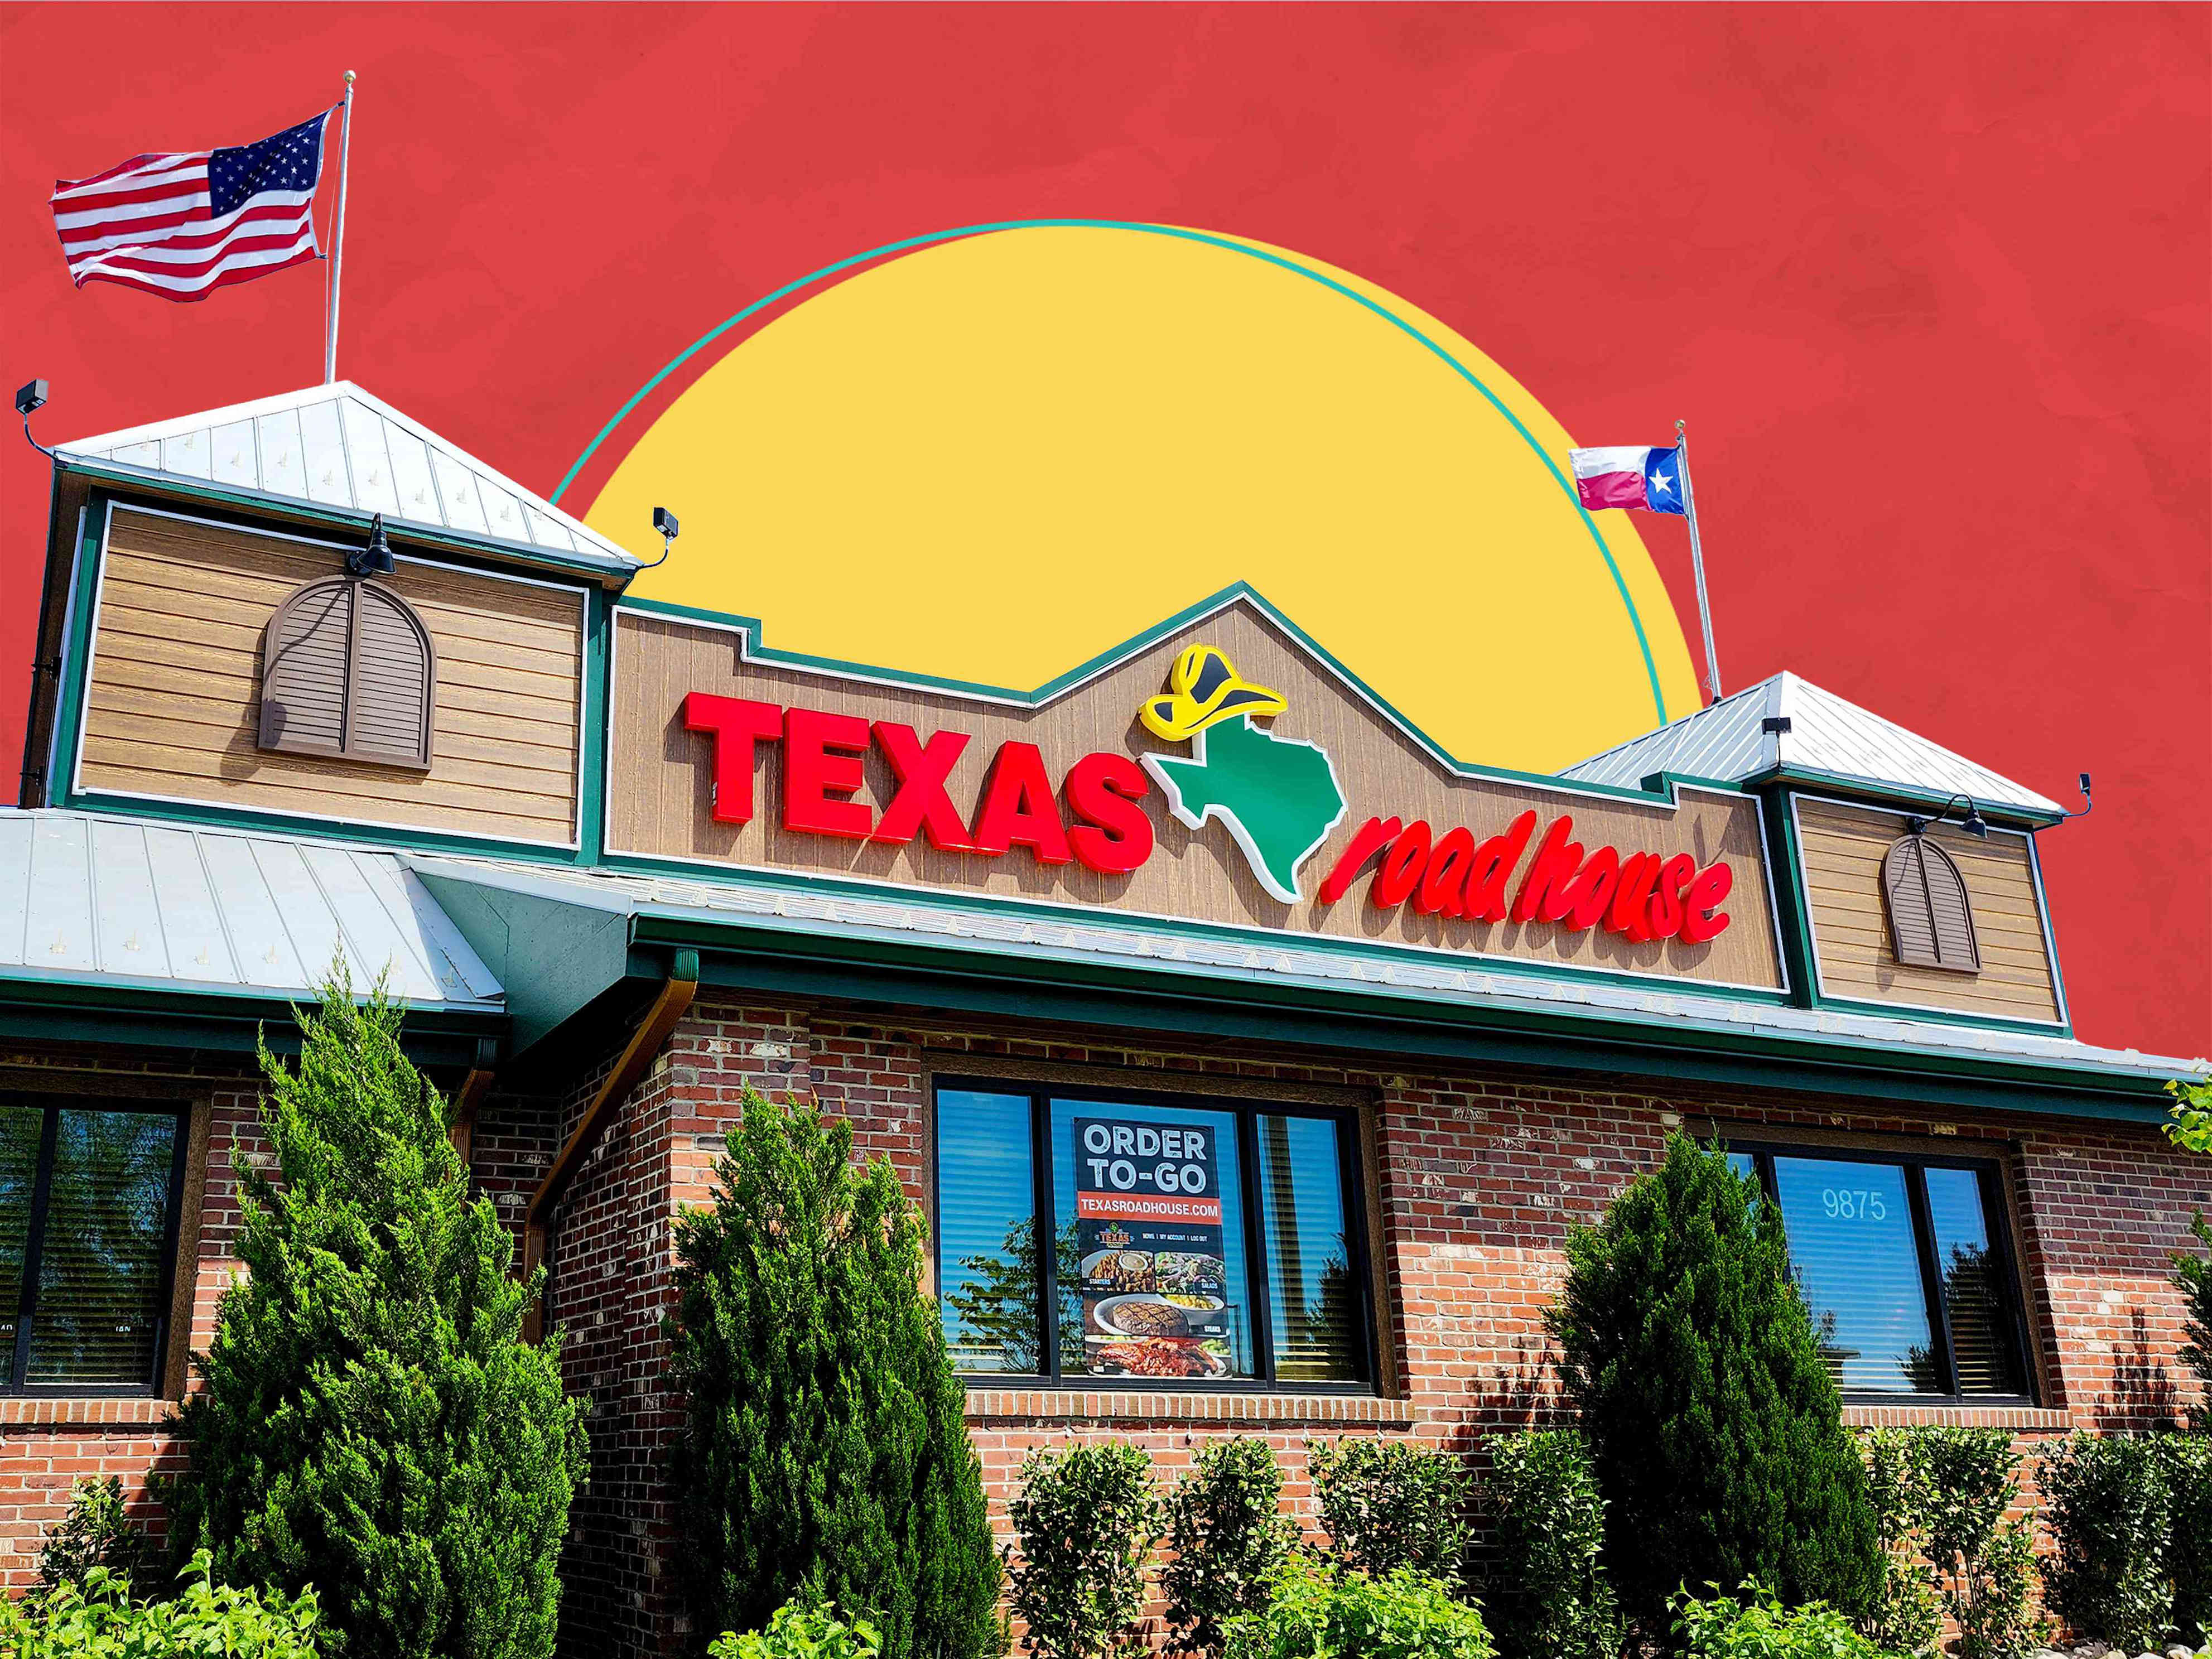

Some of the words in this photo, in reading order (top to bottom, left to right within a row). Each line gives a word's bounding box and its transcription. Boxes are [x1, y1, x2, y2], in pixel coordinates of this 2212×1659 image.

[684, 692, 1154, 875] TEXAS
[1084, 1124, 1207, 1160] ORDER
[1087, 1158, 1206, 1194] TO-GO
[1081, 1199, 1218, 1217] TEXASROADHOUSE.COM
[1823, 1188, 1886, 1221] 9875
[1100, 1232, 1130, 1243] TEXAS
